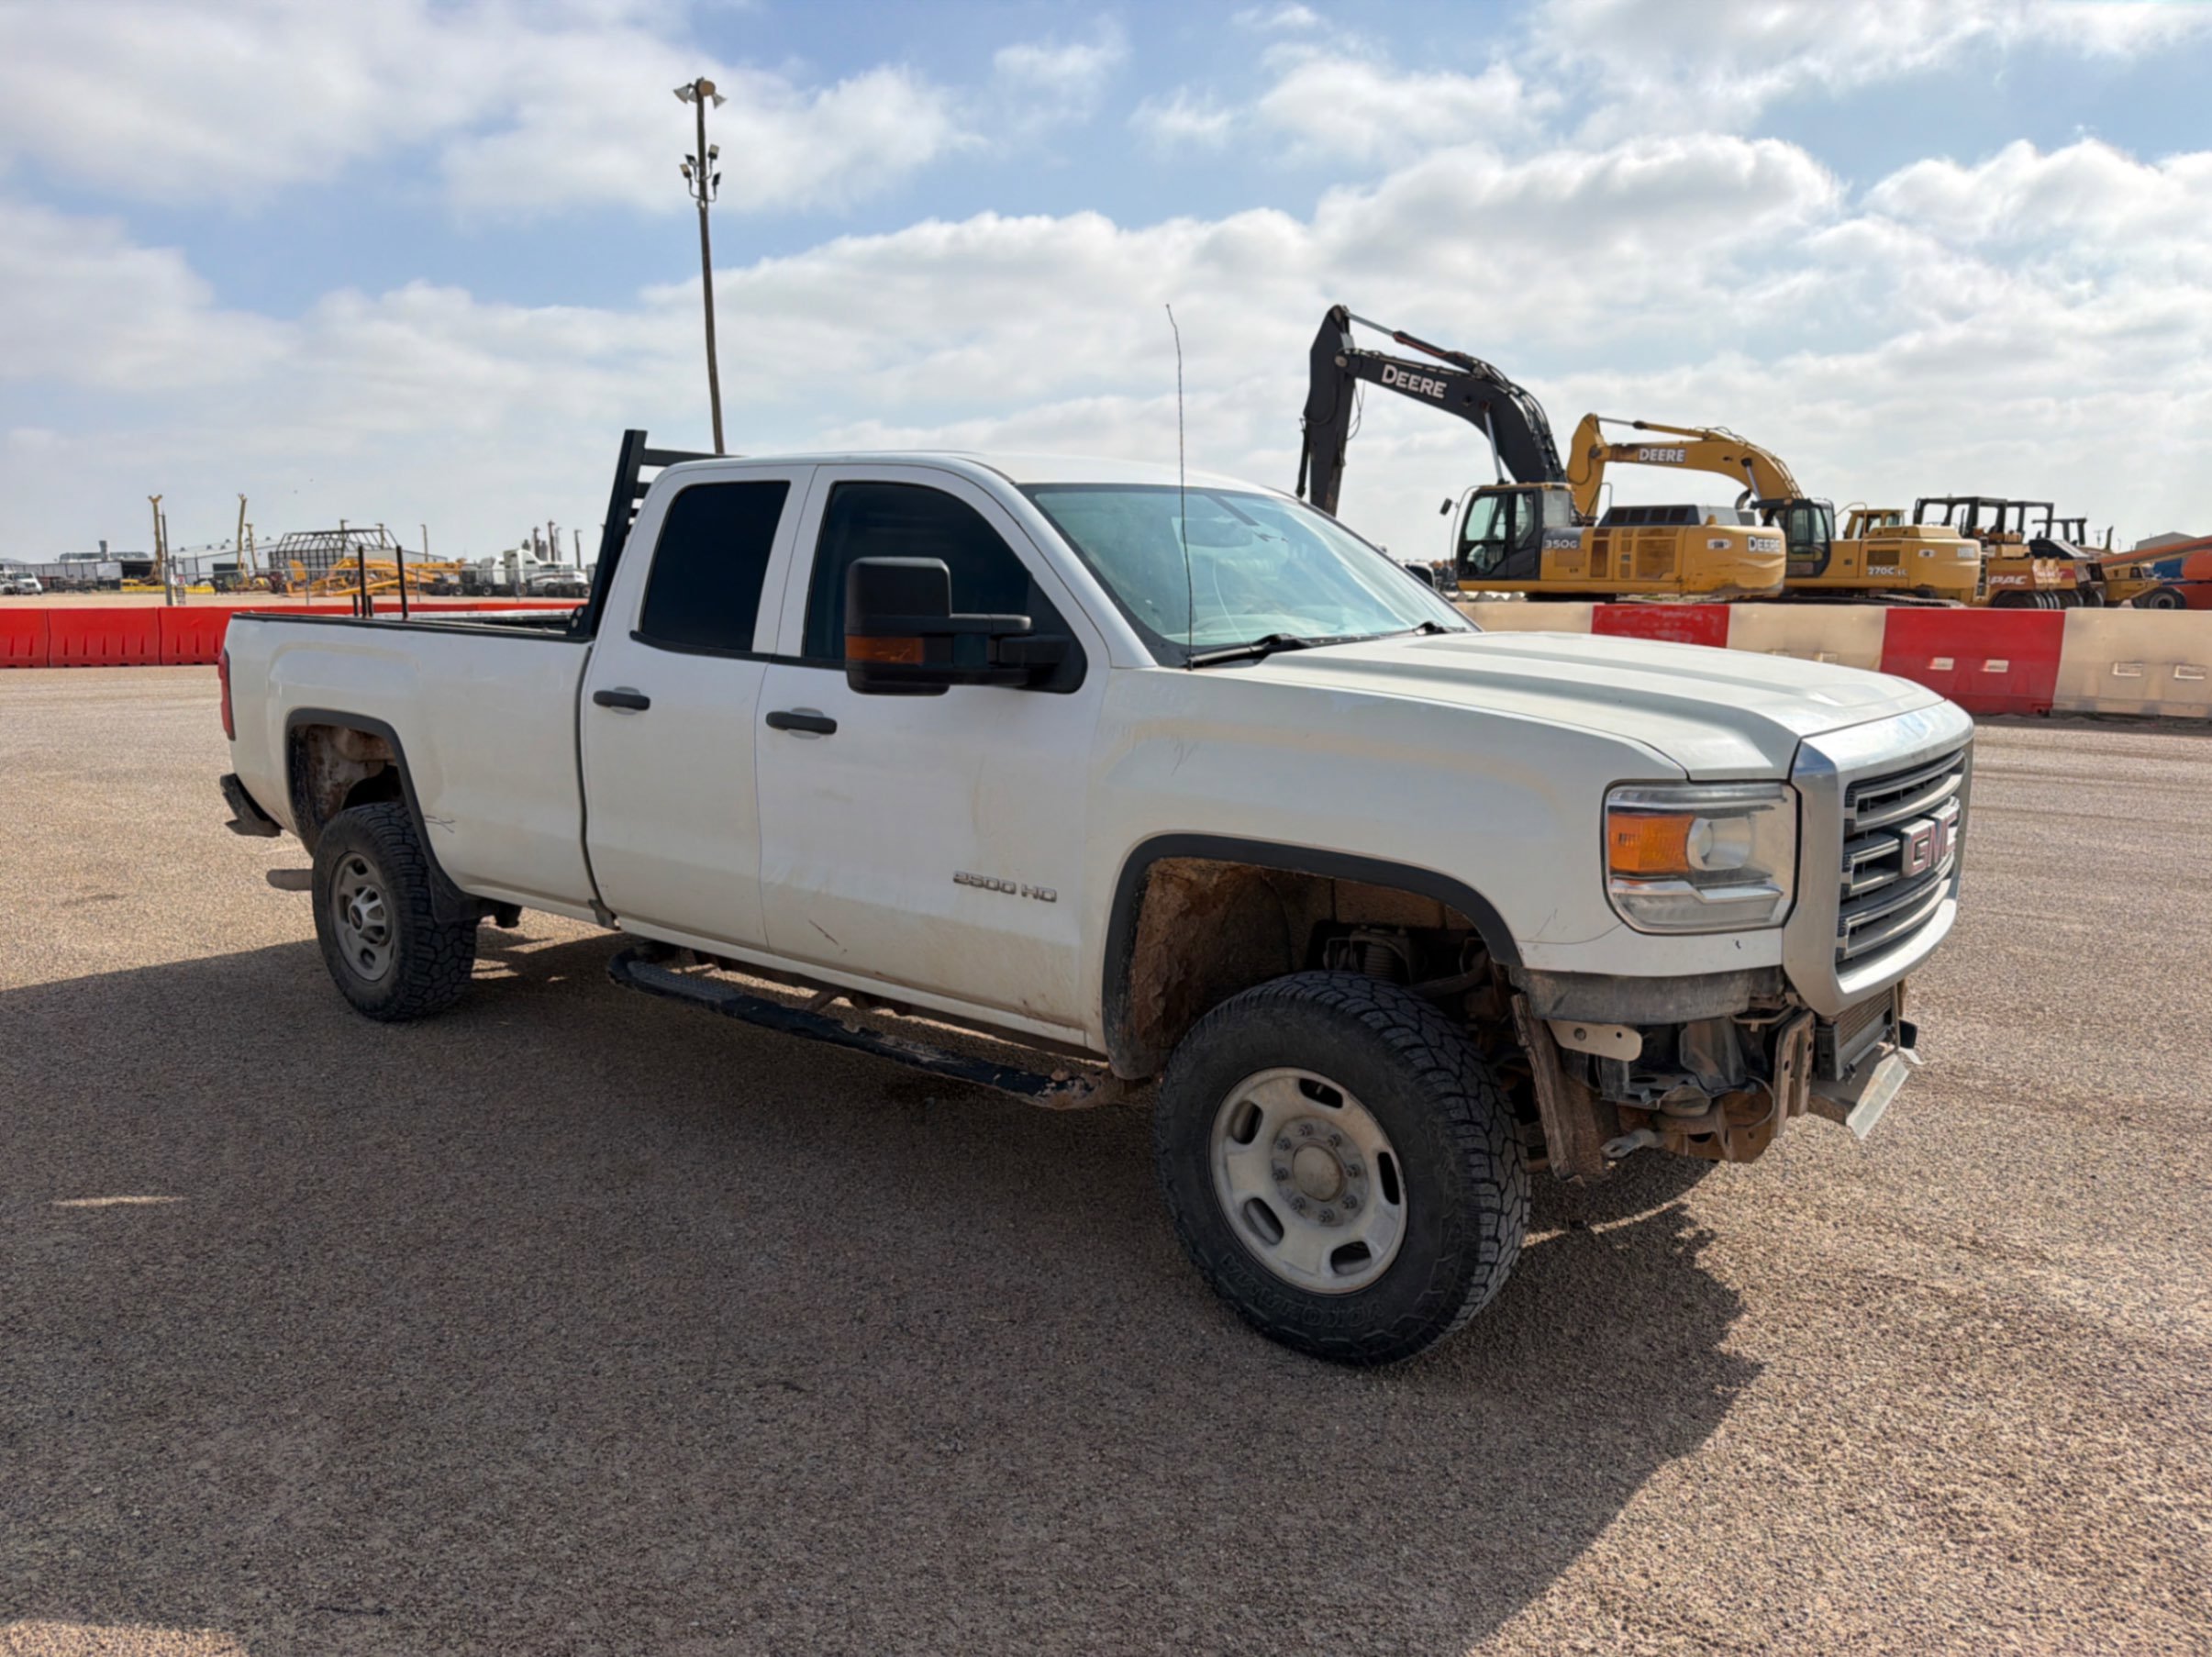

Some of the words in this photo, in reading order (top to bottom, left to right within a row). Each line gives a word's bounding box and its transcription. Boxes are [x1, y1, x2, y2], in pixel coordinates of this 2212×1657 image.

[1381, 363, 1448, 398] DEERE
[1639, 447, 1685, 463] DEERE
[1747, 536, 1781, 553] DEERE
[1902, 806, 1958, 877] GMC
[953, 871, 1017, 895] 2500
[1021, 884, 1057, 903] HD
